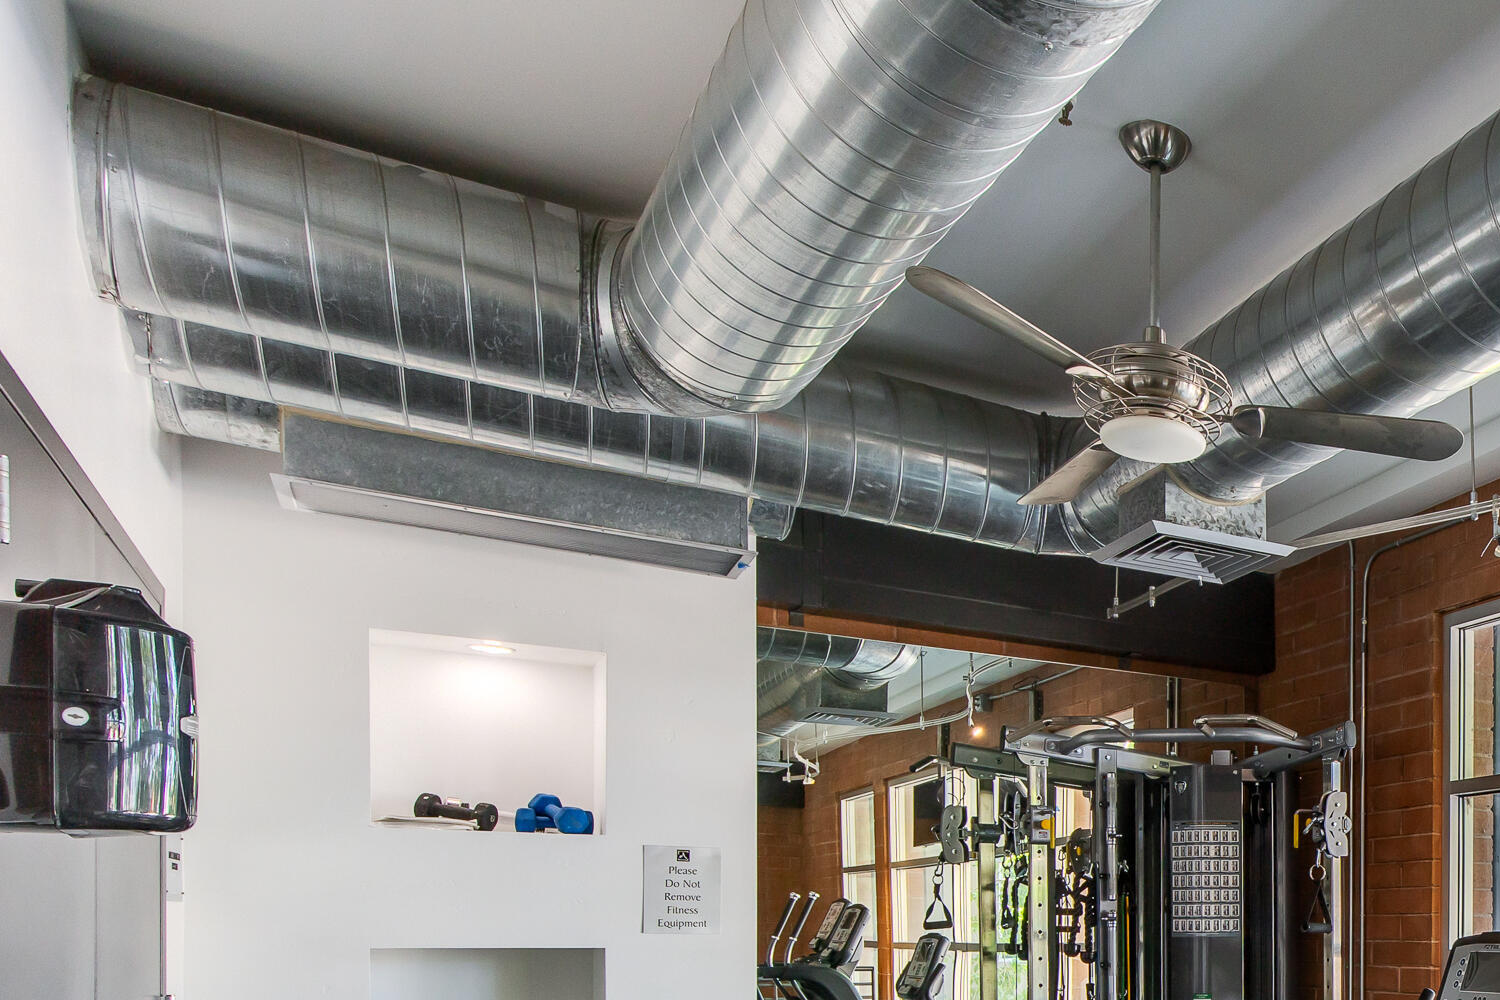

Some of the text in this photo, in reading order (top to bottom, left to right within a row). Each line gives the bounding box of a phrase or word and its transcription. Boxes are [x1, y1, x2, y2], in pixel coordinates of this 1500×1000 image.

[668, 866, 698, 875] Please
[665, 879, 701, 888] Do Not
[664, 892, 701, 902] Remove
[667, 905, 699, 915] Fitness
[657, 918, 707, 930] Equipment
